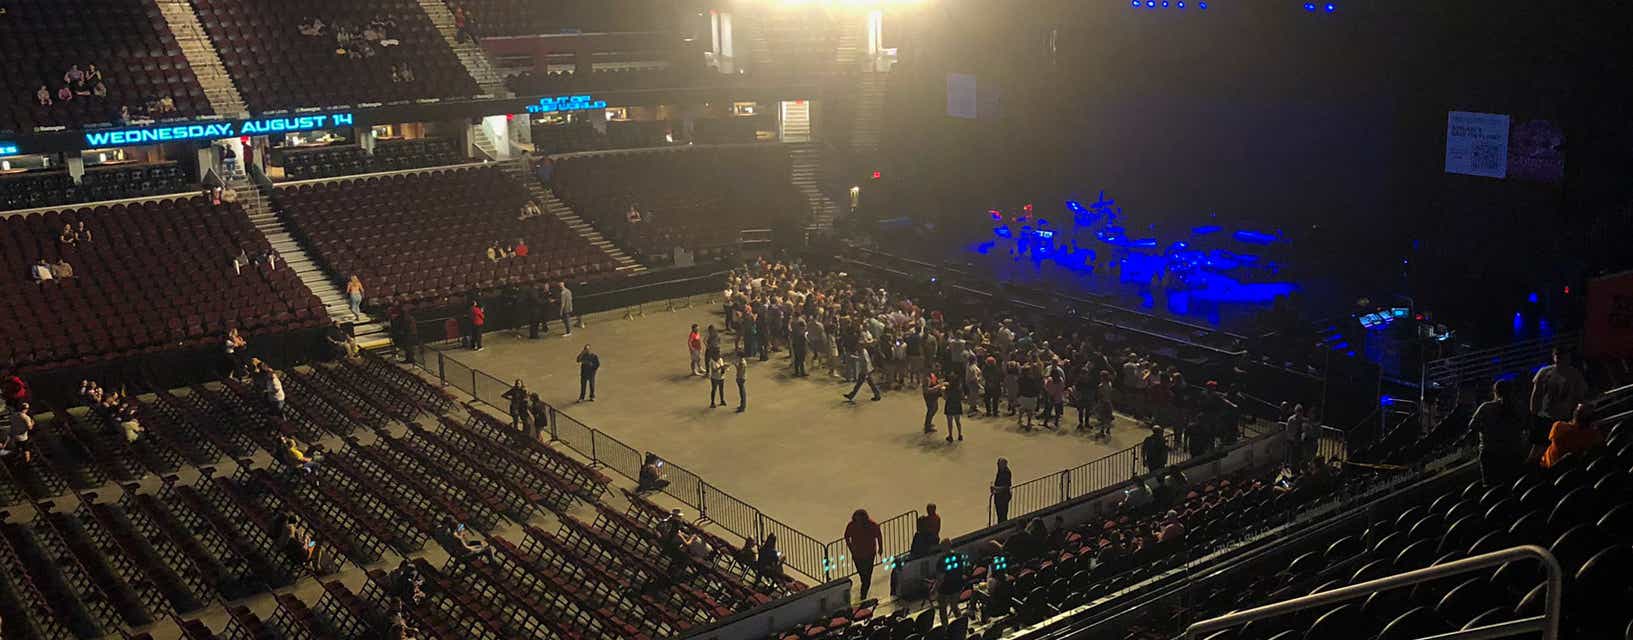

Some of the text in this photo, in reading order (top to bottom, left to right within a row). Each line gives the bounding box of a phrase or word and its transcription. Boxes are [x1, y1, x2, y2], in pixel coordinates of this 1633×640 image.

[86, 122, 234, 145] WEDNESDAY,
[241, 116, 326, 134] AUGUST
[332, 113, 352, 126] 14
